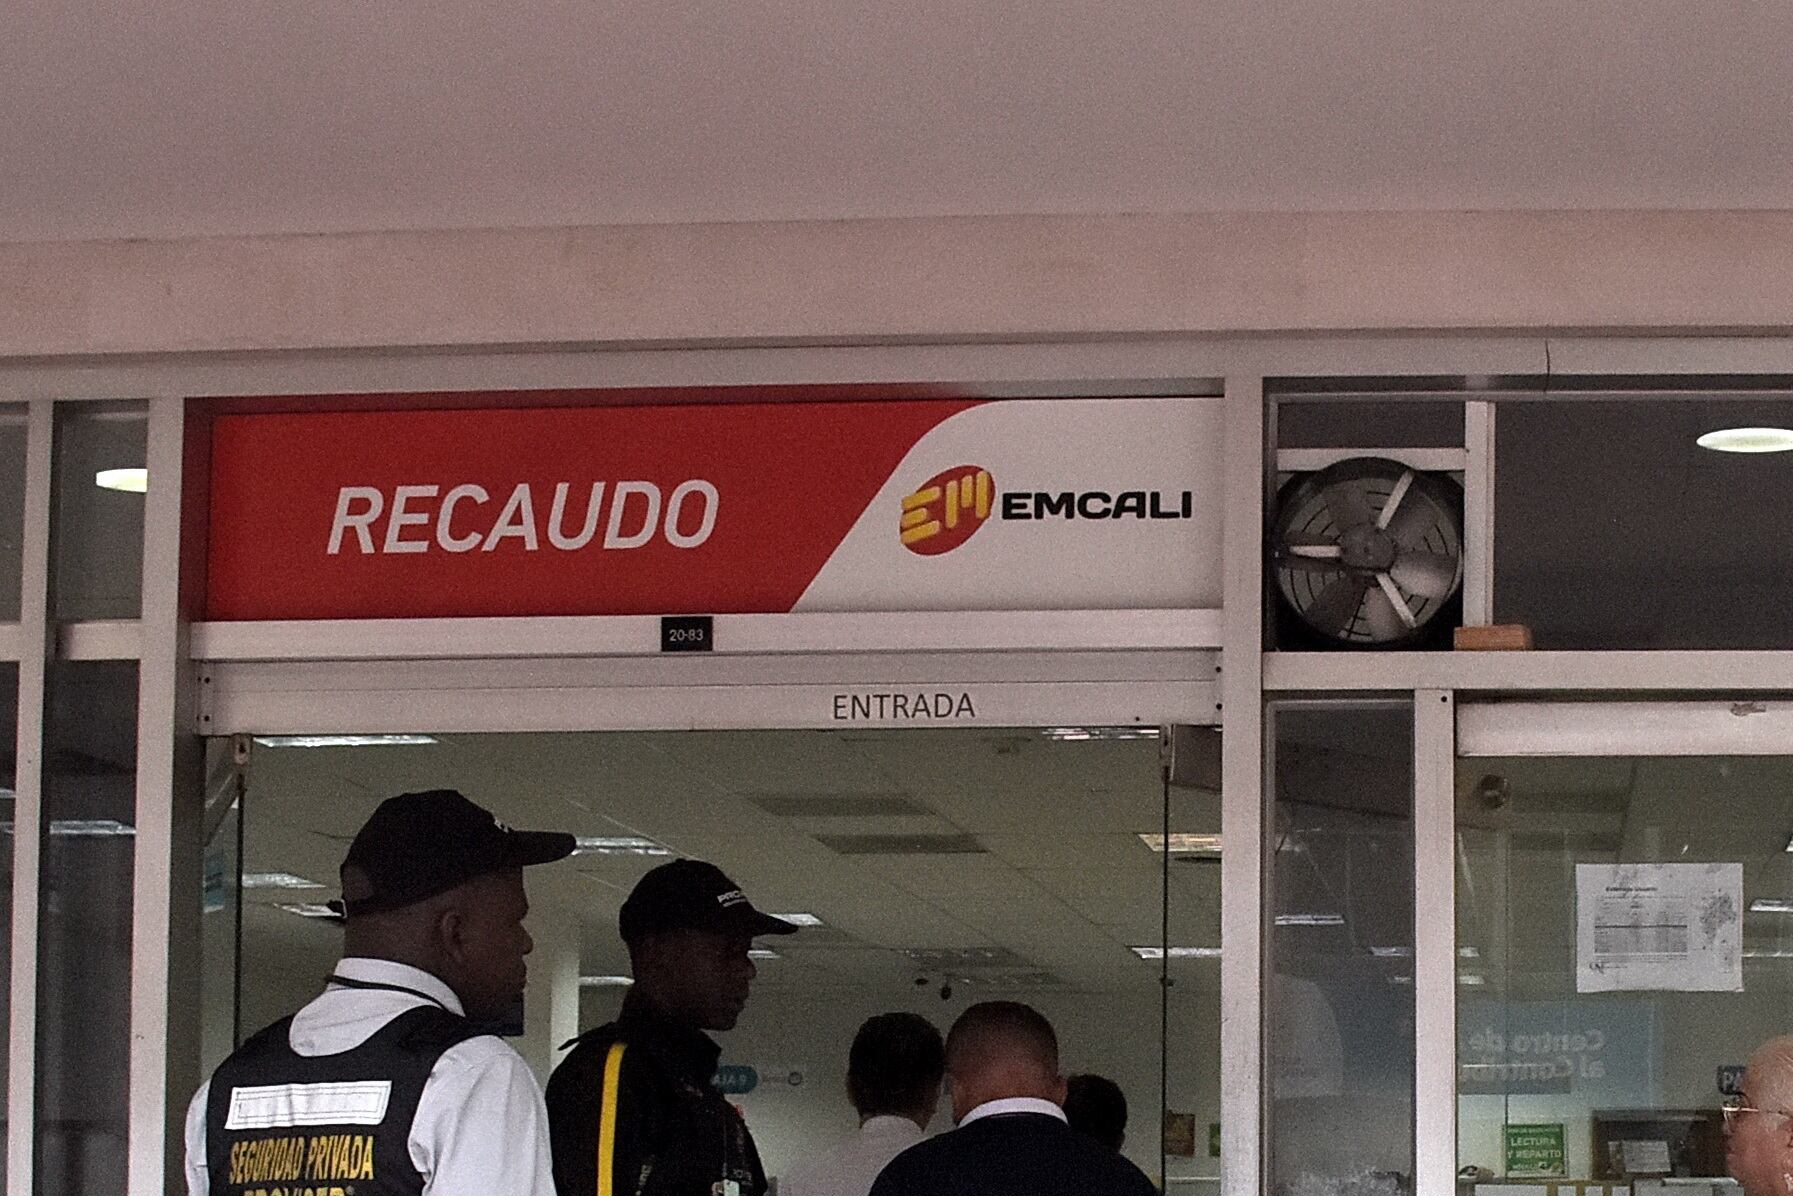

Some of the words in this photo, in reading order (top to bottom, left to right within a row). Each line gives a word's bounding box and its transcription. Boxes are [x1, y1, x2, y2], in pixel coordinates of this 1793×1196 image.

[327, 479, 720, 555] RECAUDO
[1001, 490, 1193, 520] EMCALI
[668, 628, 705, 642] 20-83
[832, 692, 976, 720] ENTRADA
[1510, 1137, 1557, 1147] LECTURA
[1515, 1149, 1562, 1158] REPARTO
[229, 1136, 305, 1185] SEGURIDAD
[305, 1134, 374, 1181] PRIVADA
